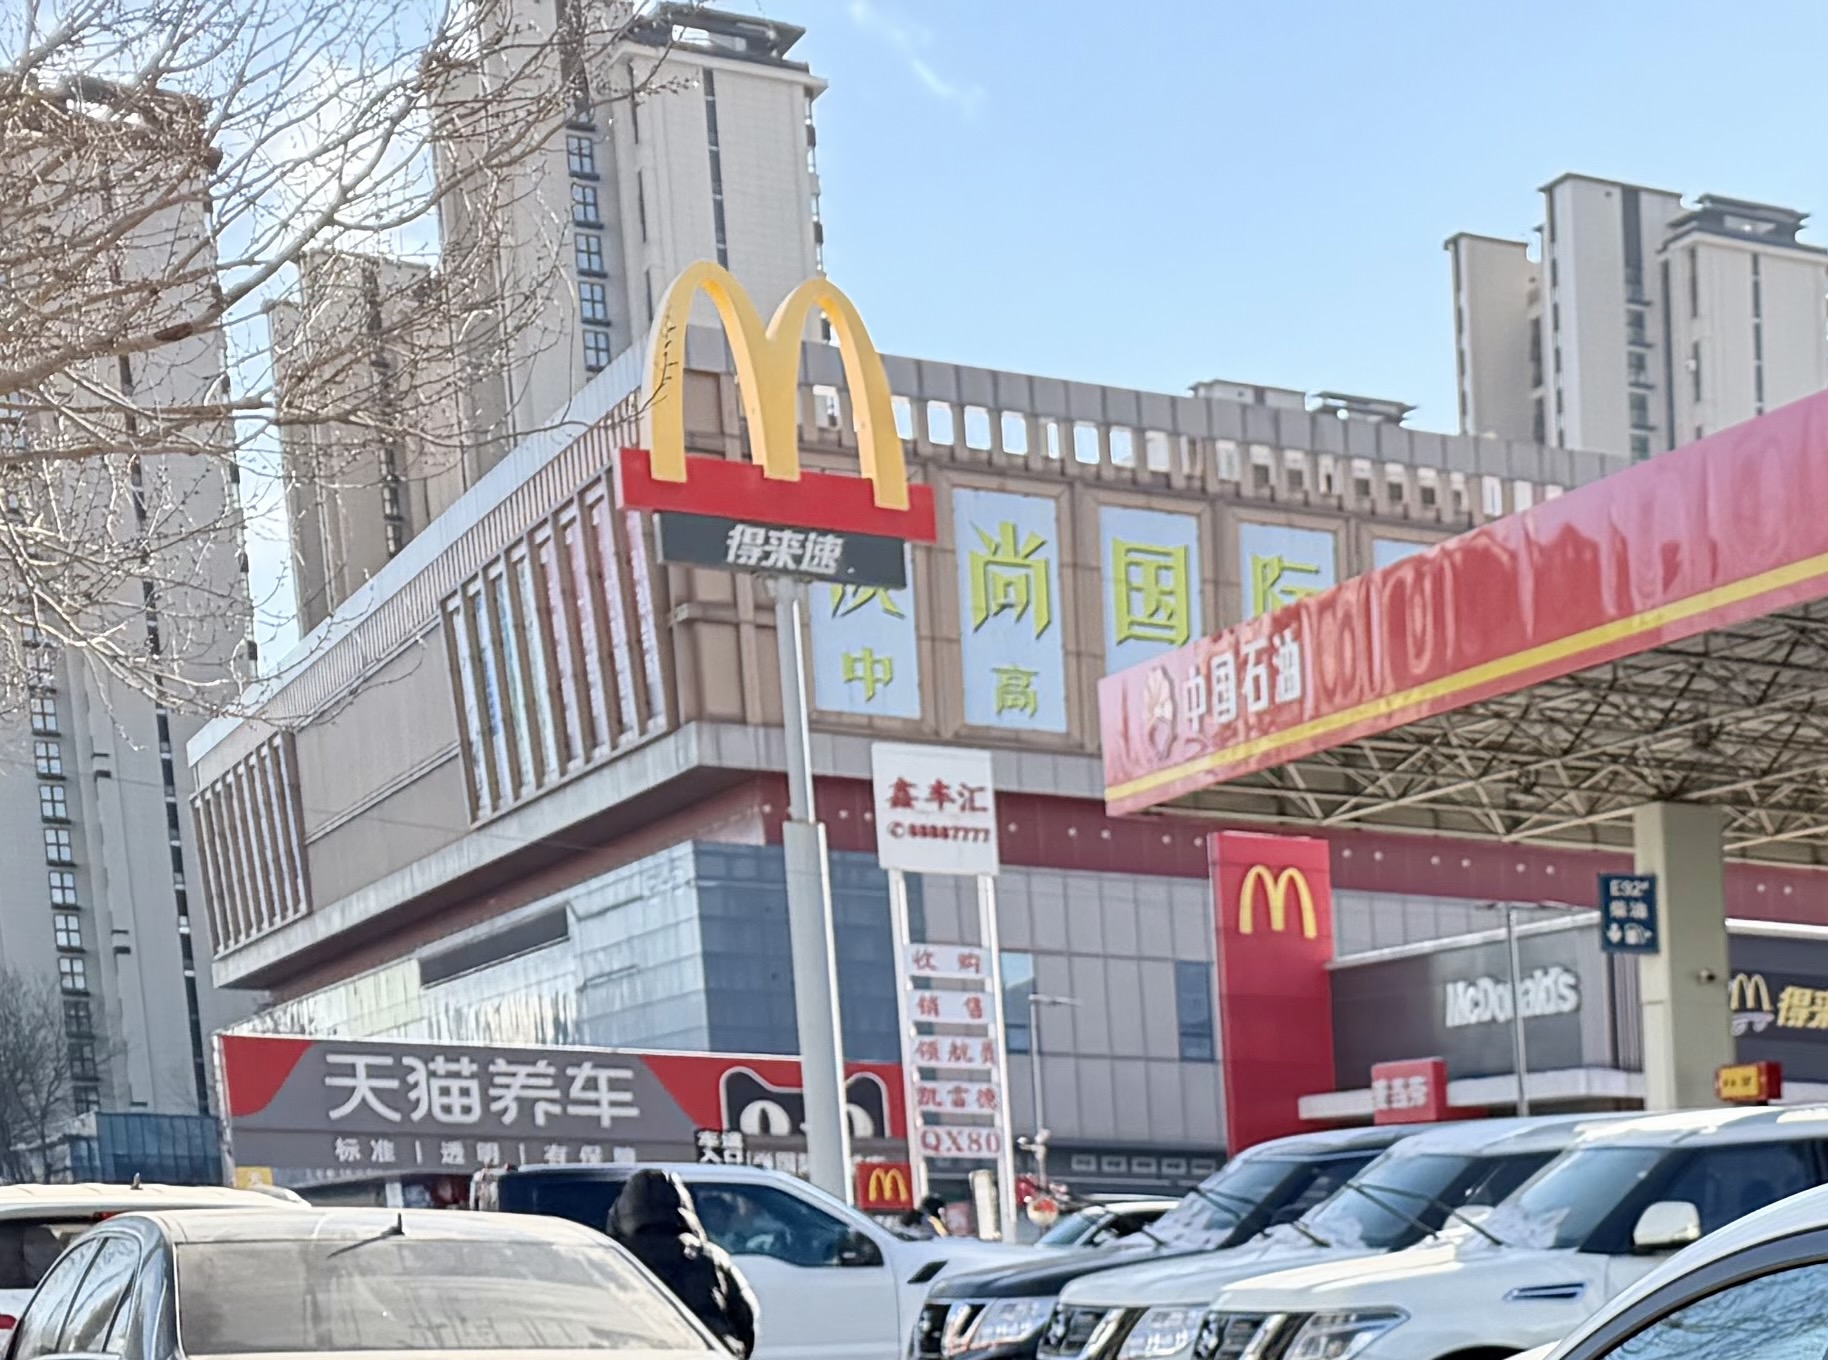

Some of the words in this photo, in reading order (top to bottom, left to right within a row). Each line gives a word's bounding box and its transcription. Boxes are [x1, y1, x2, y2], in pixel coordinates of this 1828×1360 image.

[726, 523, 844, 575] 得来速
[1182, 628, 1302, 733] 中国石油
[1446, 966, 1580, 1027] McDoald's
[324, 1053, 641, 1129] 天猫养车
[920, 1129, 1000, 1156] QX80
